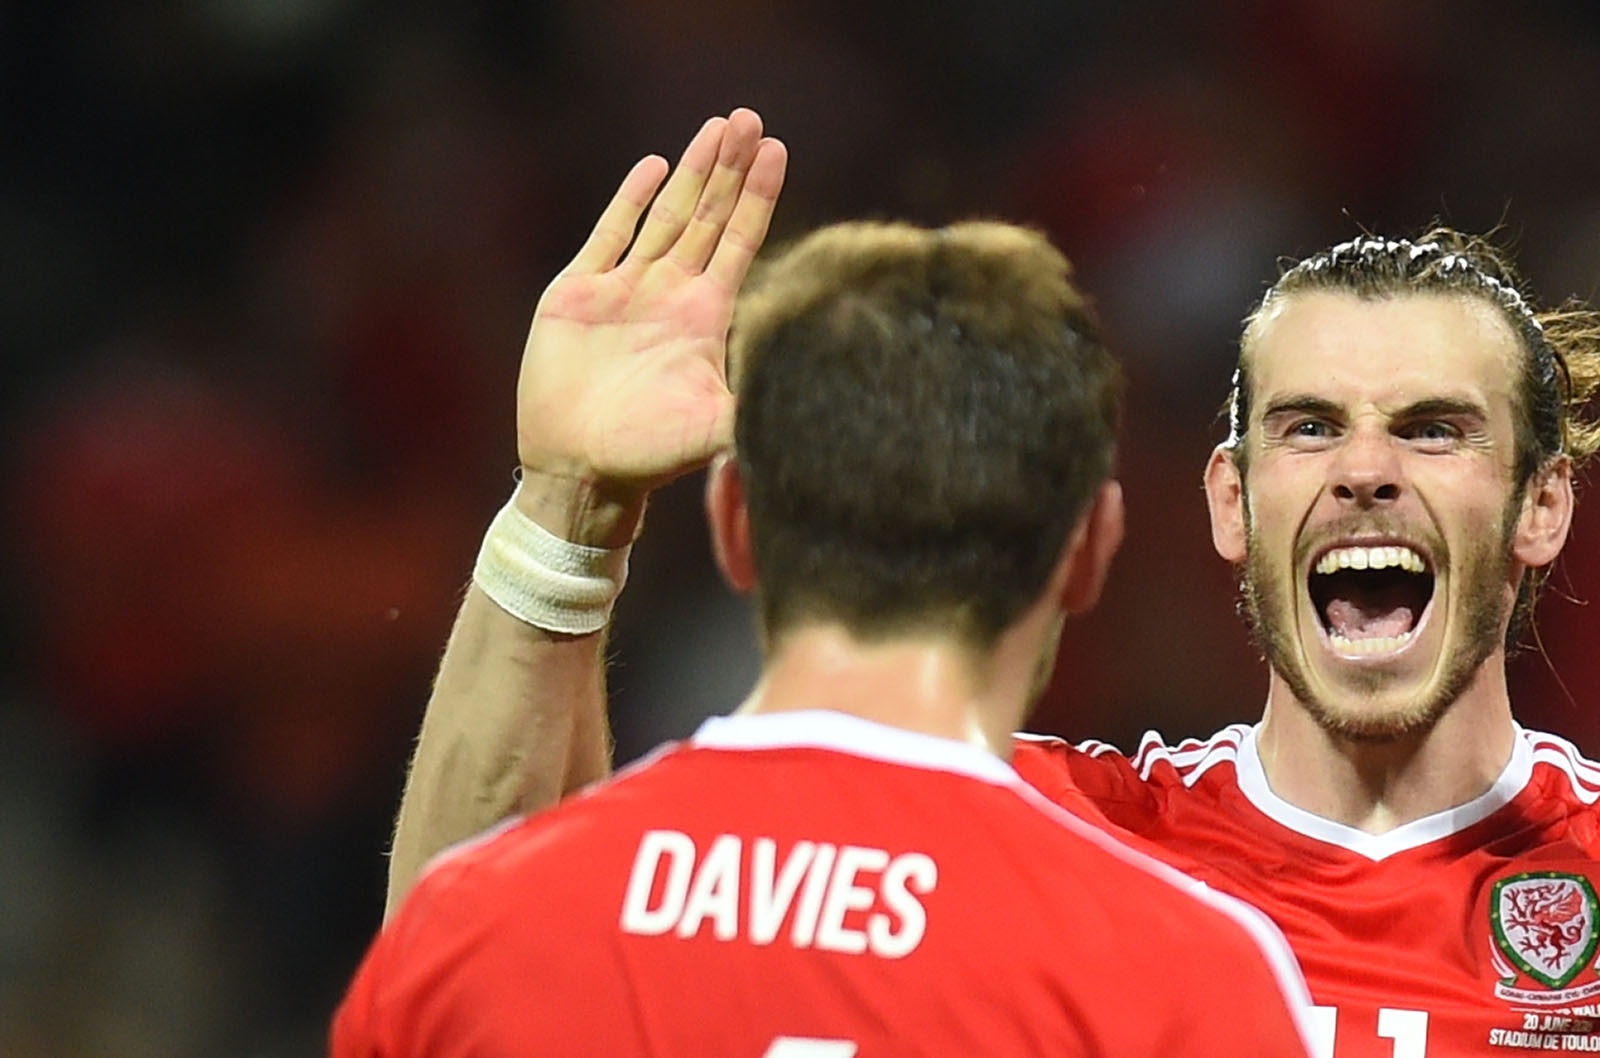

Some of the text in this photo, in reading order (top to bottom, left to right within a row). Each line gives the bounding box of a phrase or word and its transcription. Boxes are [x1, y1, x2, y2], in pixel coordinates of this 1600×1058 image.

[620, 829, 939, 960] DAVIES
[1523, 1013, 1539, 1031] 20
[1540, 1015, 1572, 1032] JUNE
[1489, 1028, 1542, 1048] STADIUM
[1543, 1033, 1559, 1050] DE
